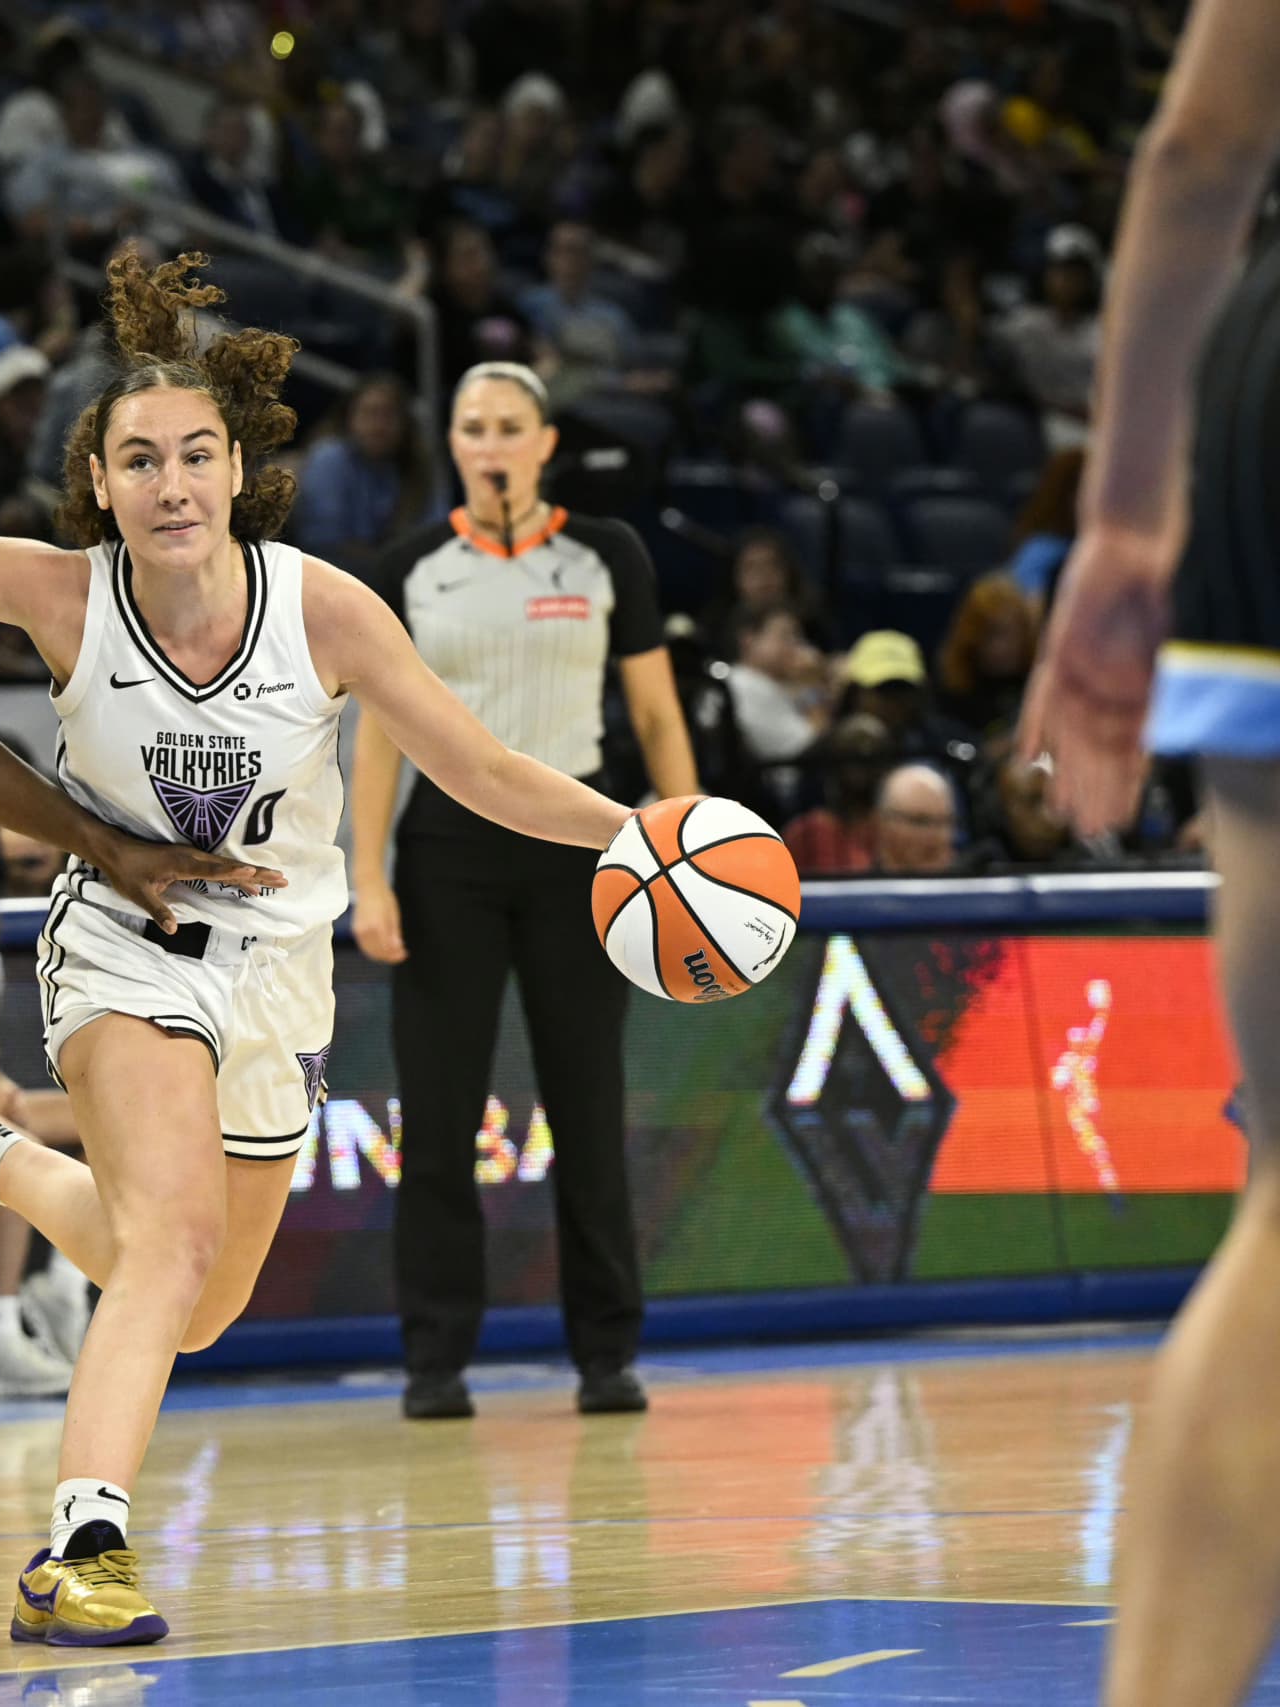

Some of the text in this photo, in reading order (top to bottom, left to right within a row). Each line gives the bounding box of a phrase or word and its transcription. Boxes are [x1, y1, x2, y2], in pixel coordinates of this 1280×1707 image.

[256, 682, 295, 699] freedom
[156, 731, 246, 750] GOLDEN STATE
[140, 745, 262, 789] VALKYRIES
[242, 788, 288, 845] 0
